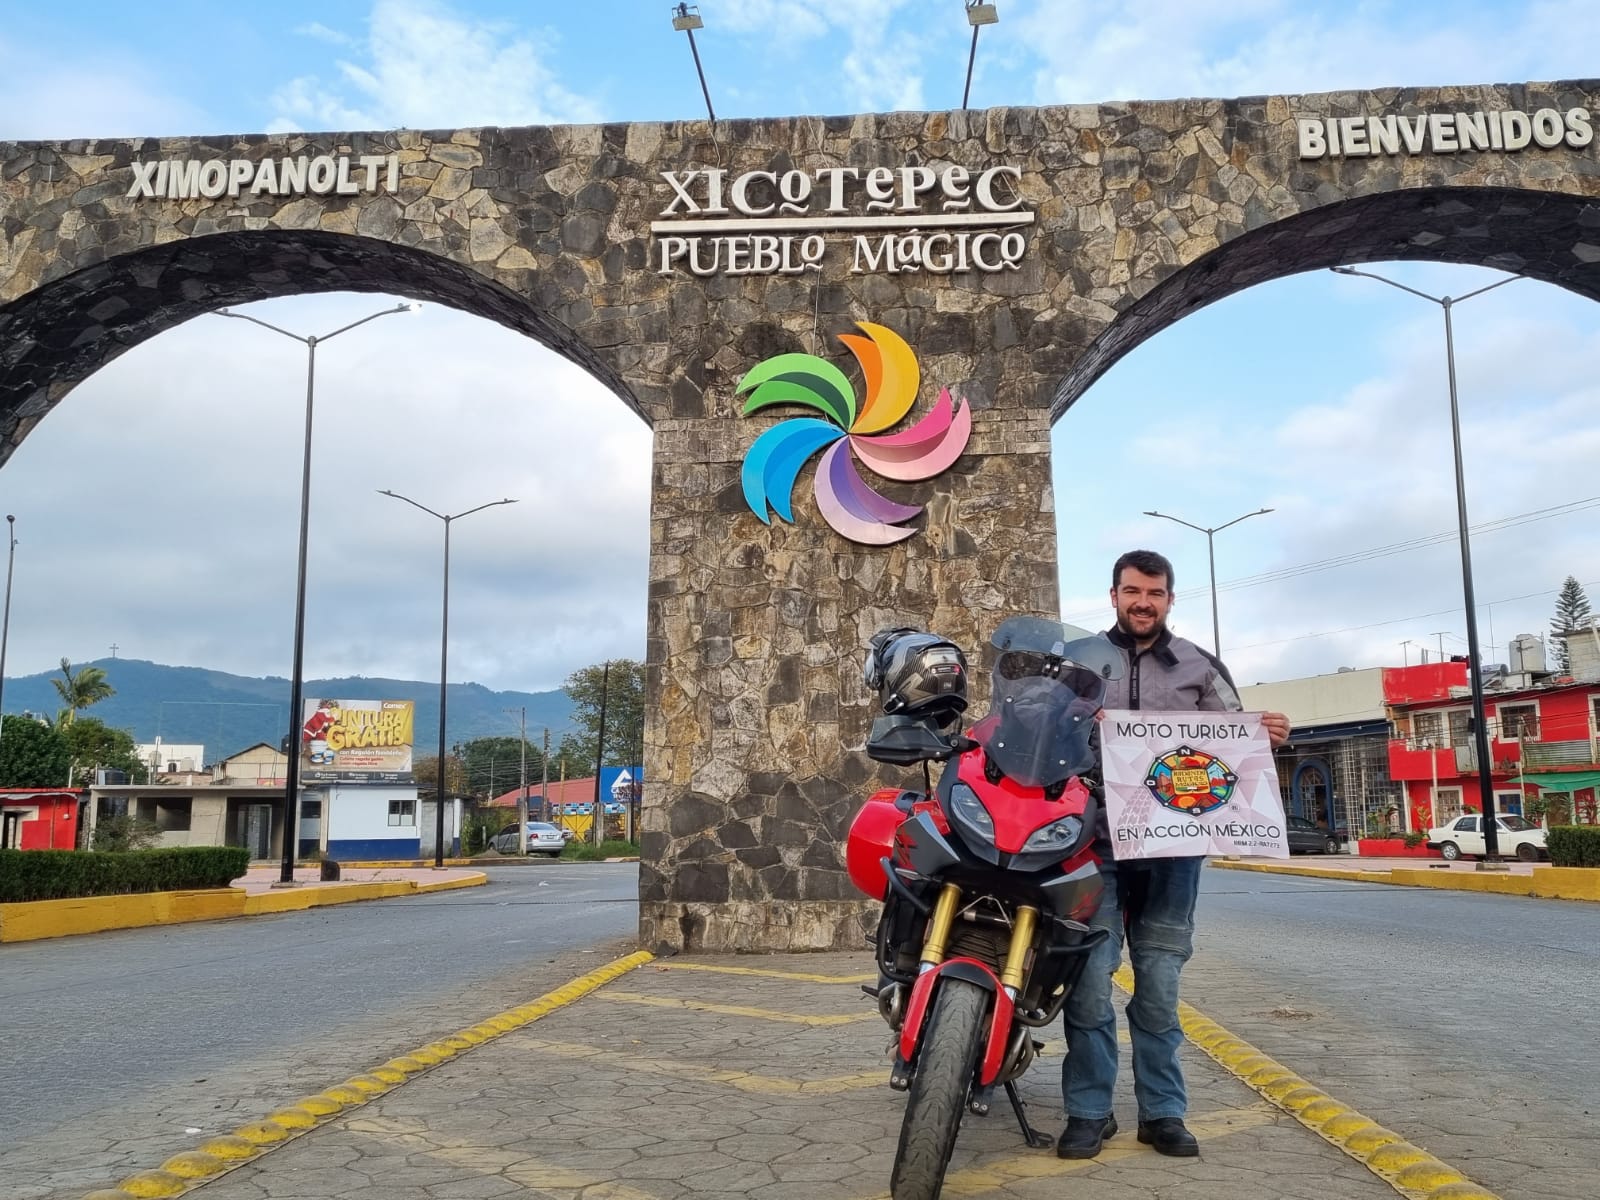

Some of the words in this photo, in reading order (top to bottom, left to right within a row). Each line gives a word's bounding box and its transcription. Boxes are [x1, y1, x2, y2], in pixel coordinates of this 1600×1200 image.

[1298, 107, 1594, 160] BIENVENIDOS
[126, 155, 399, 200] XIMOPANOLTI
[657, 234, 826, 277] PUEBLO
[383, 702, 408, 710] Comex
[329, 707, 404, 731] PINTURA
[1117, 723, 1172, 738] MOTO
[1178, 724, 1249, 739] TURISTA
[326, 725, 405, 751] GRATIS
[1117, 829, 1139, 842] EN
[1144, 821, 1212, 838] ACCIÓN
[1216, 821, 1281, 839] MÉXICO
